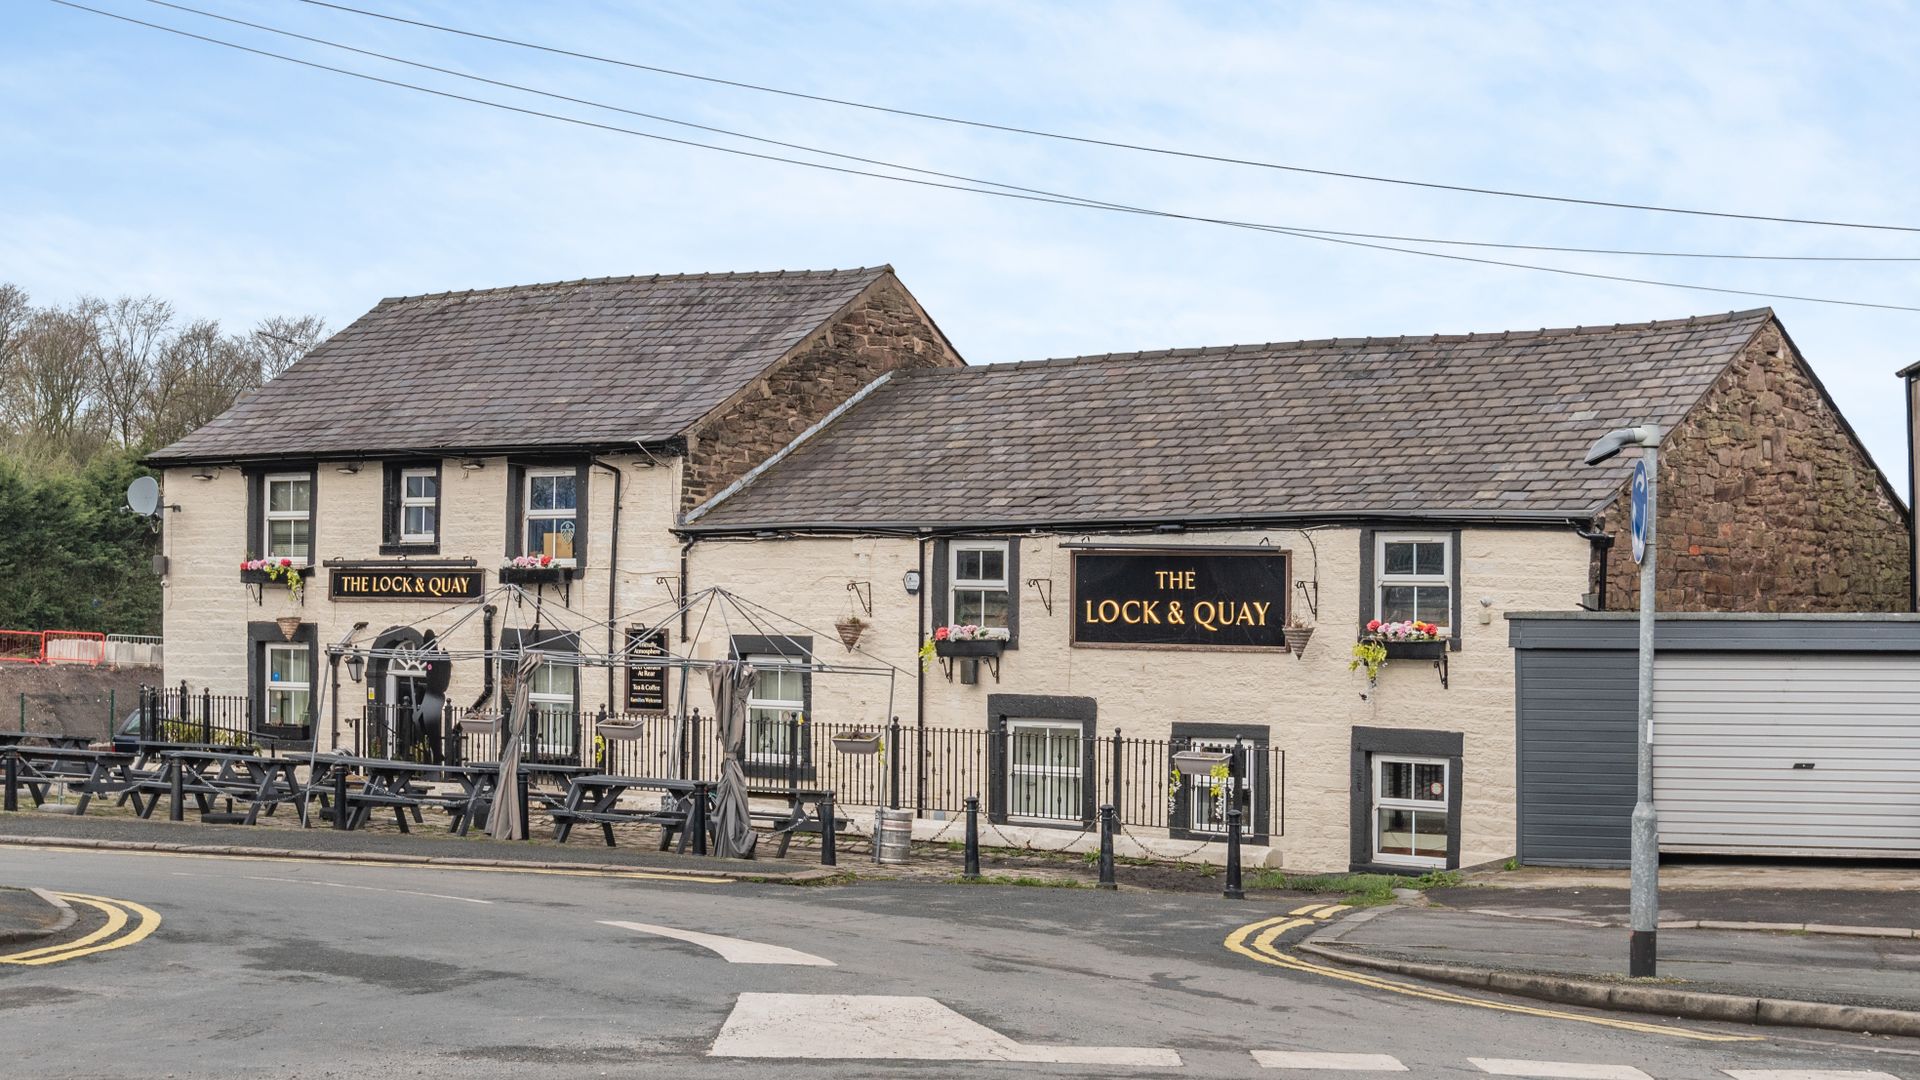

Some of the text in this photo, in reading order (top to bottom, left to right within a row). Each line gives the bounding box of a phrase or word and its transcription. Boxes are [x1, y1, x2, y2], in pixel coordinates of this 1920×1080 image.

[342, 576, 470, 596] THE LOCK & QUAY
[1155, 571, 1196, 590] THE
[1086, 600, 1271, 631] LOCK & QUAY
